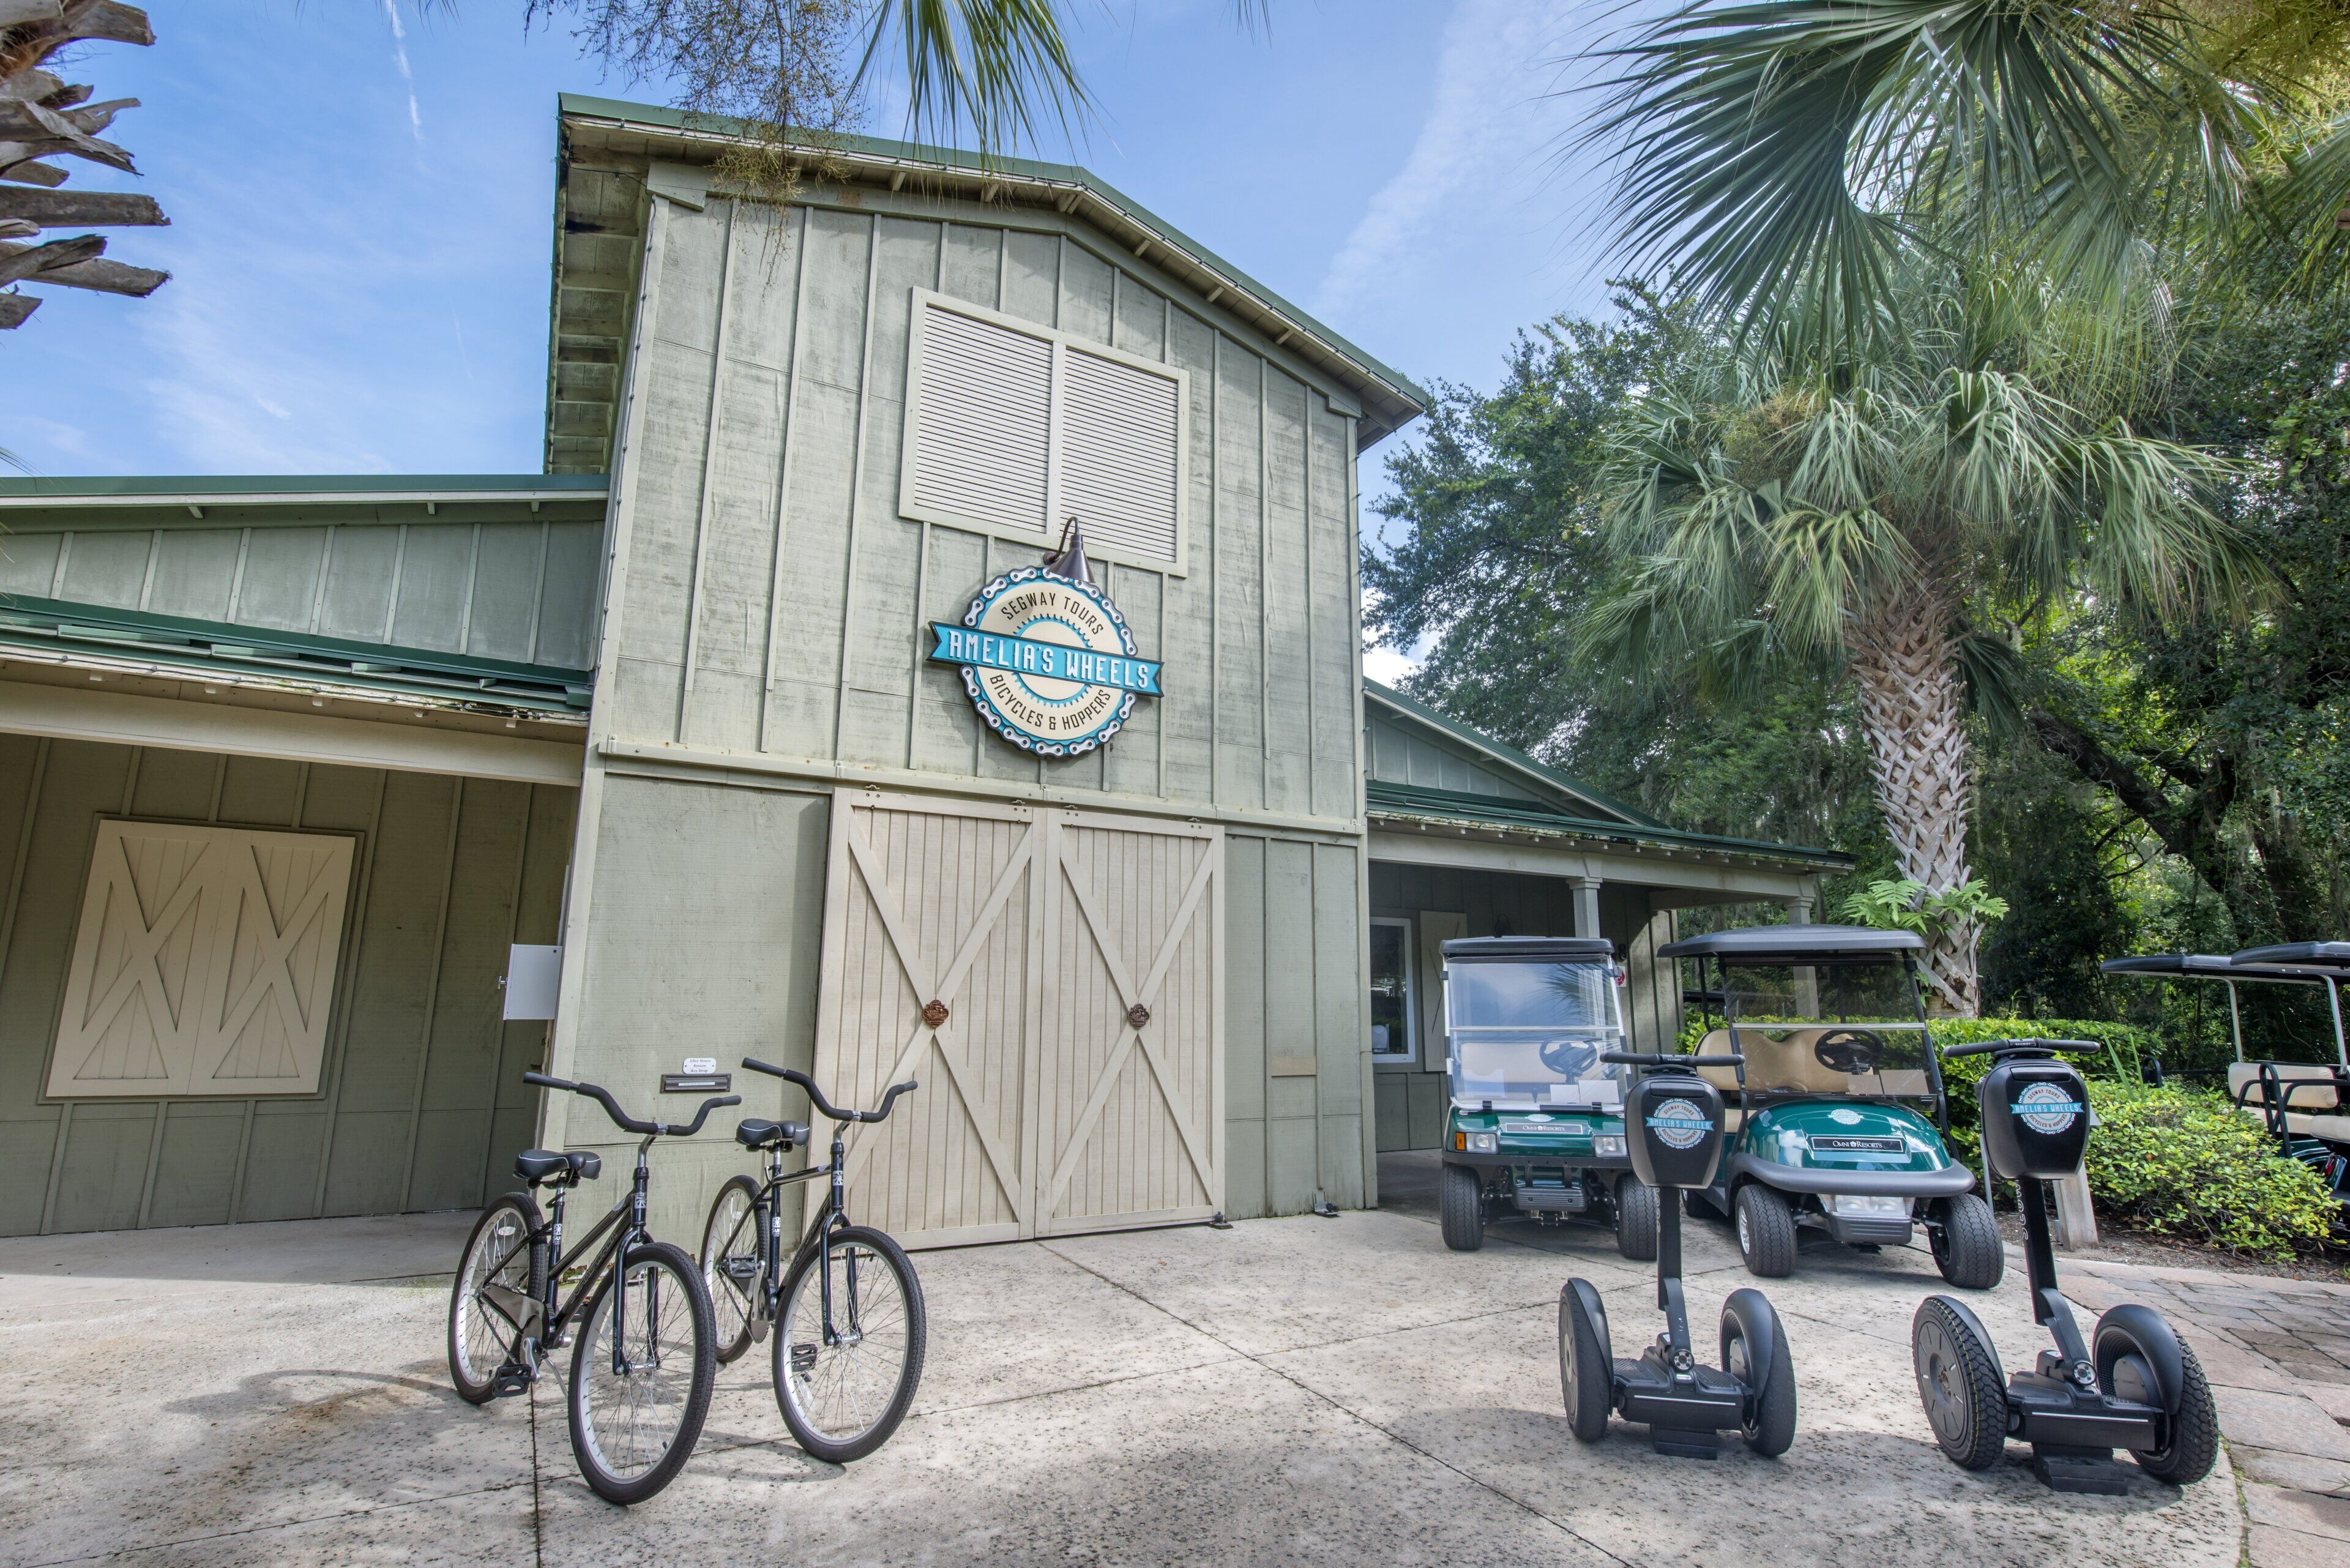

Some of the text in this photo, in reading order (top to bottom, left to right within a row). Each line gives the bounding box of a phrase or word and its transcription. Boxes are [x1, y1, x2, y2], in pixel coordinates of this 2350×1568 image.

[1001, 592, 1103, 635] SEGWAY TOURS
[949, 630, 1148, 688] AMELIA'S WHEELS
[990, 674, 1111, 730] BICYCLES & HOPPERS
[2027, 1089, 2061, 1100] SEGWAY TOURS
[1663, 1105, 1695, 1116] SEGWAY TOURS
[1683, 1121, 1709, 1129] WHEELS
[2029, 1114, 2048, 1128] BICYCLES
[2053, 1114, 2067, 1127] HOPPERS
[1662, 1129, 1677, 1142] BICYCLES
[1683, 1130, 1698, 1143] HOPPERS
